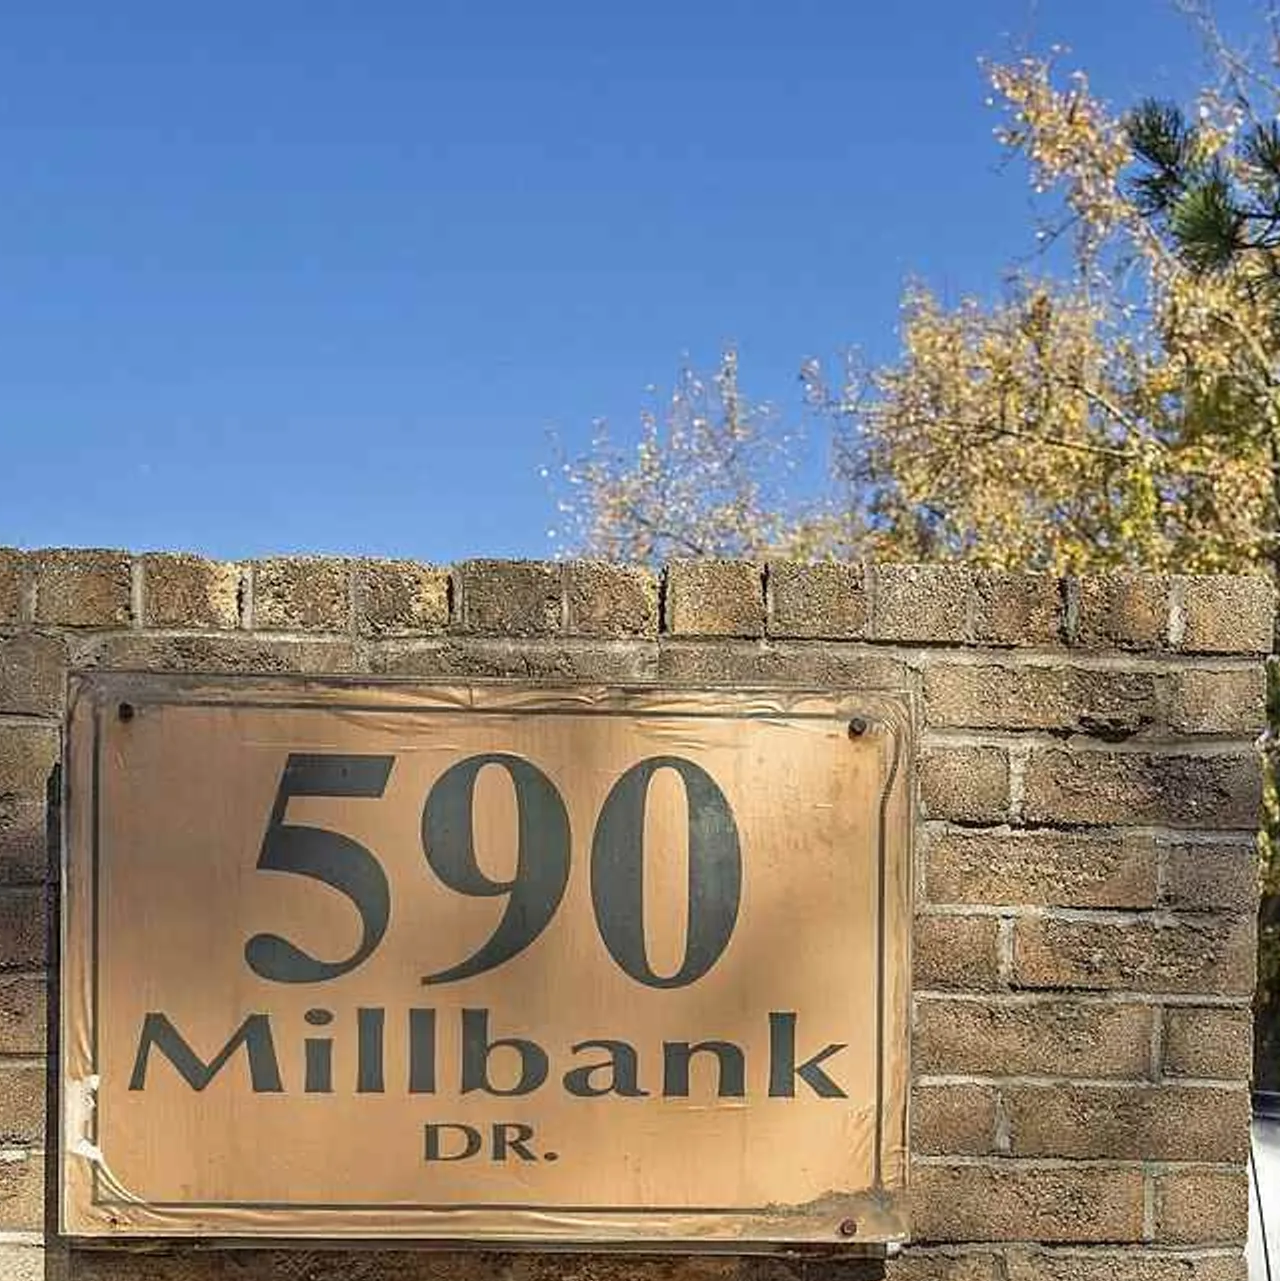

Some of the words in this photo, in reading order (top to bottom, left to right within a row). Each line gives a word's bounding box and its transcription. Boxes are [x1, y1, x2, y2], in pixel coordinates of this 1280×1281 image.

[243, 752, 743, 989] 590
[128, 1007, 849, 1099] Millbank
[422, 1122, 559, 1163] DR.
